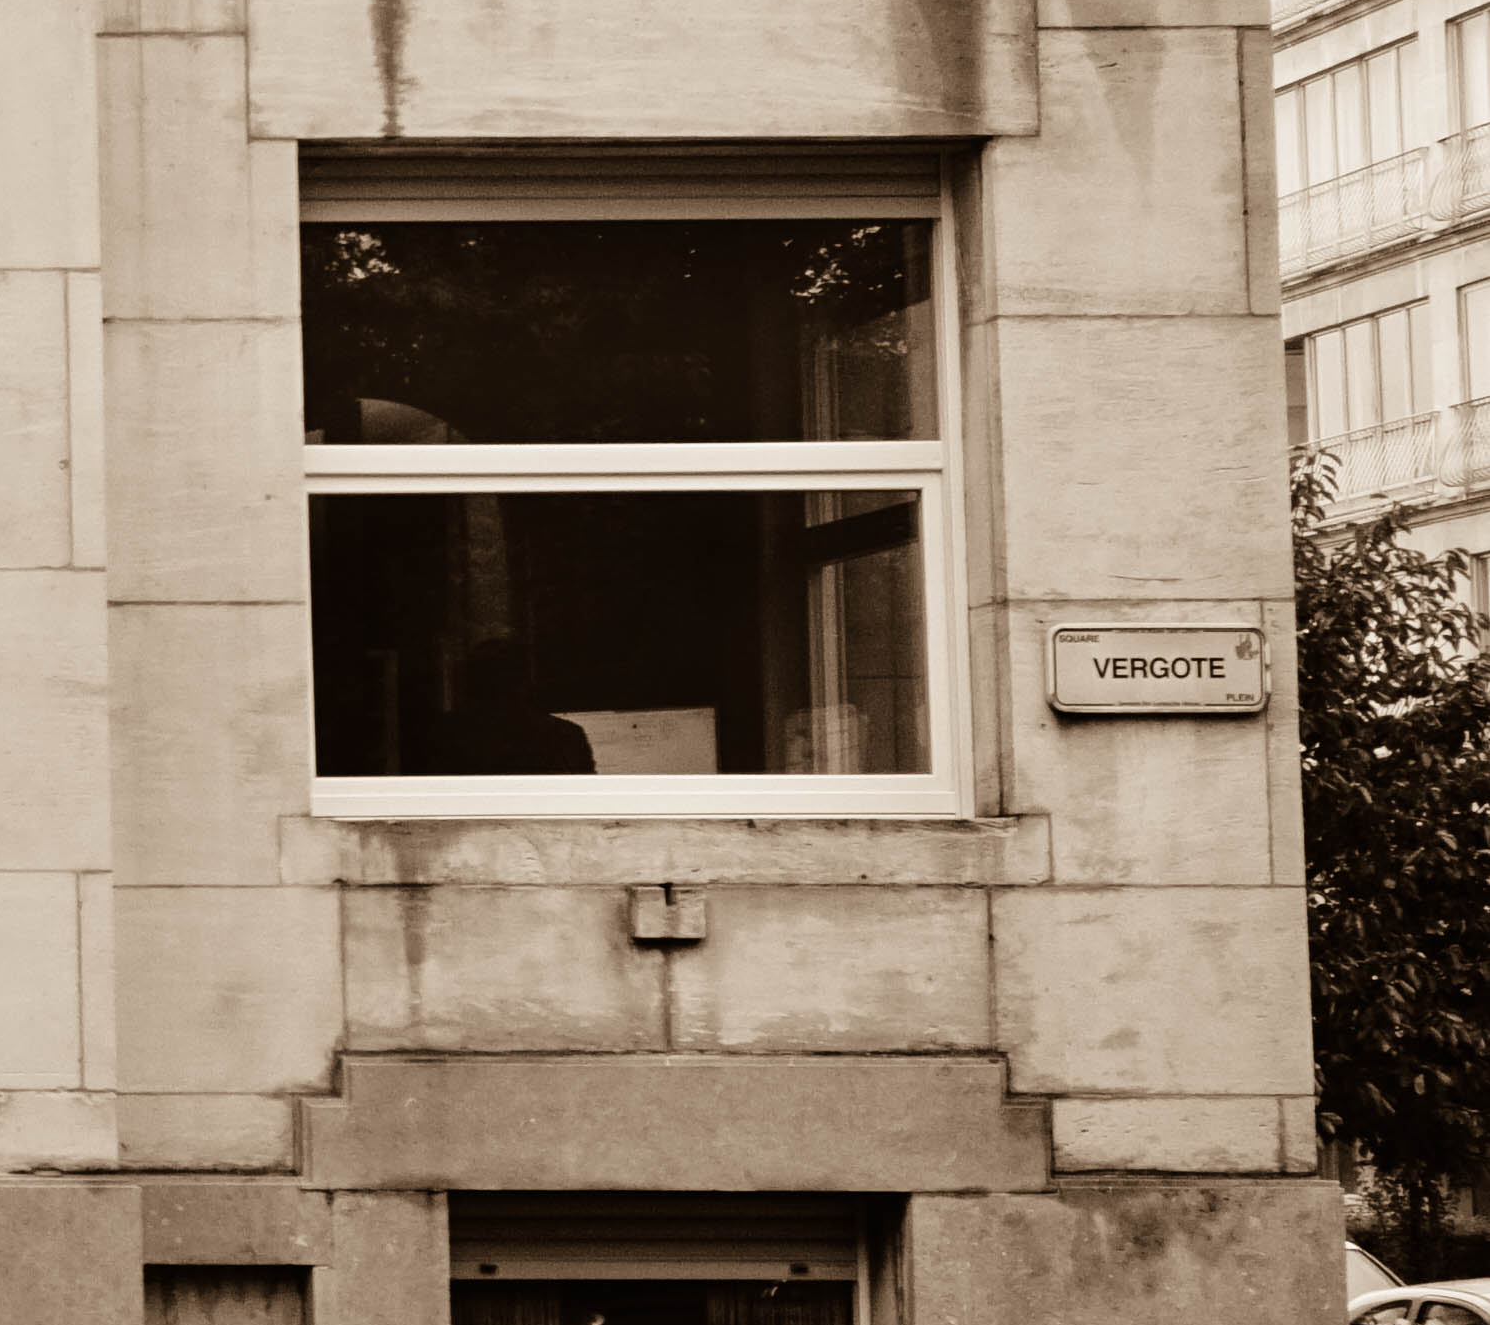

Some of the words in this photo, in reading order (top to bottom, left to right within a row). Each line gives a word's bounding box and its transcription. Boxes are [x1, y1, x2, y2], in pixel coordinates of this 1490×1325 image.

[1058, 634, 1100, 644] SQUARE
[1093, 656, 1227, 679] VERGOTE
[1225, 692, 1255, 703] PLEIN
